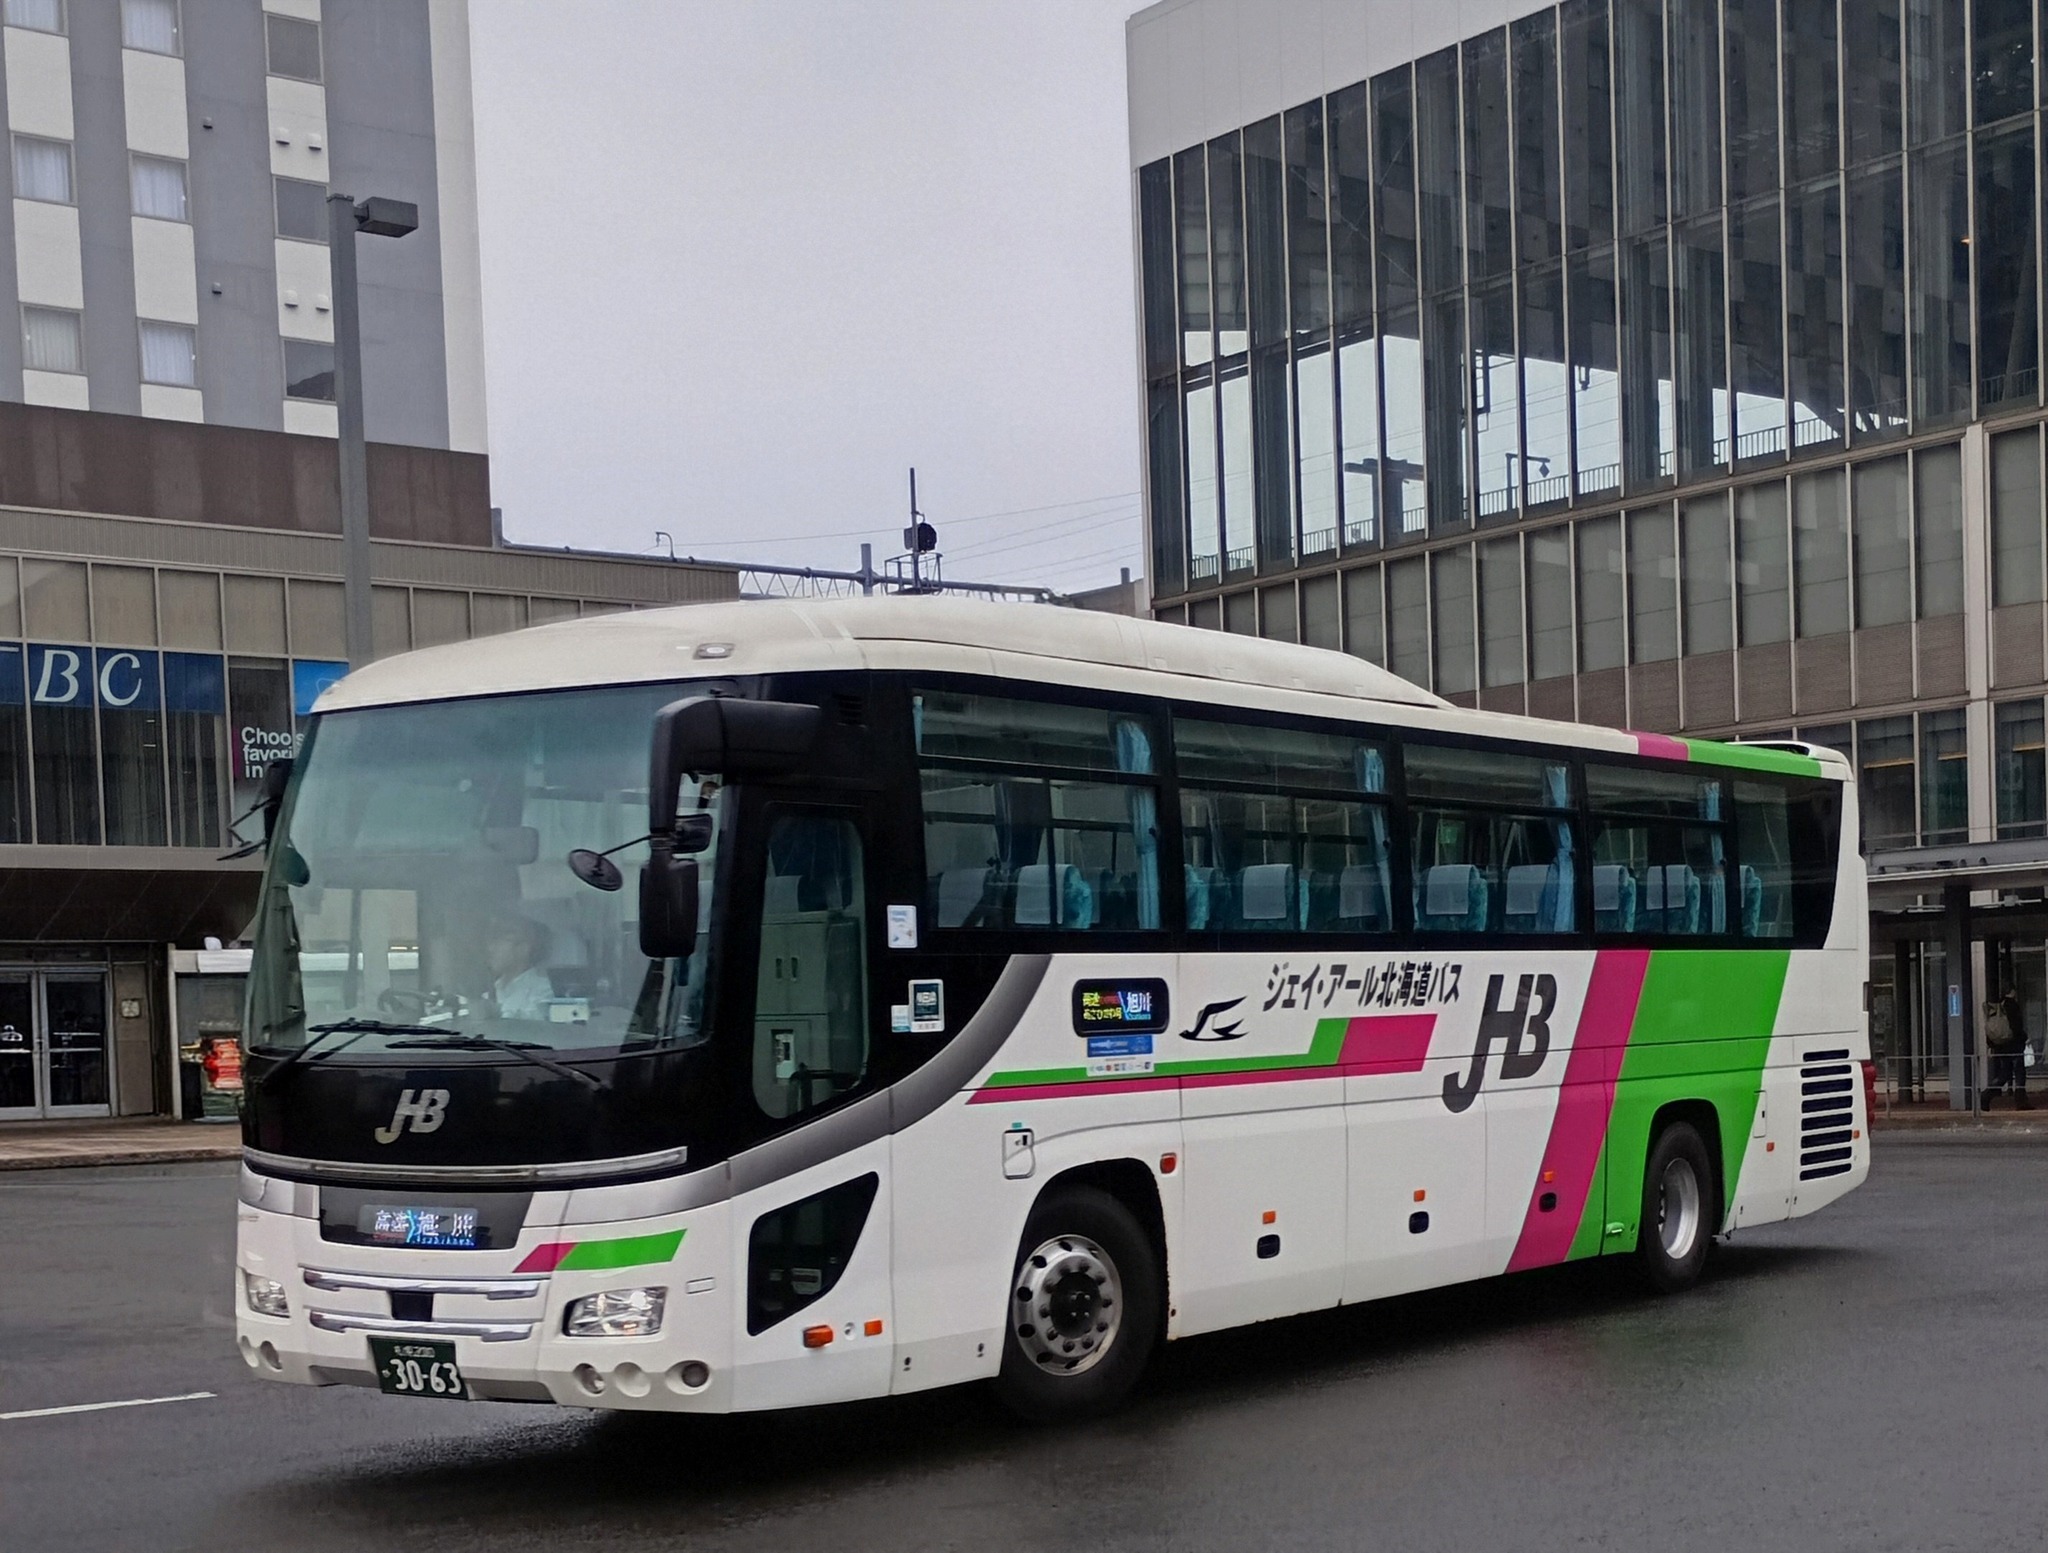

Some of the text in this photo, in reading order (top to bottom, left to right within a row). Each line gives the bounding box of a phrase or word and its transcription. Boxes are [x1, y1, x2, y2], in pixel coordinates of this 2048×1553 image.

[0, 646, 142, 706] BC
[245, 761, 263, 778] in
[1262, 960, 1463, 1012] ジェイ・アール北海道バス
[389, 1358, 462, 1394] 30-63
